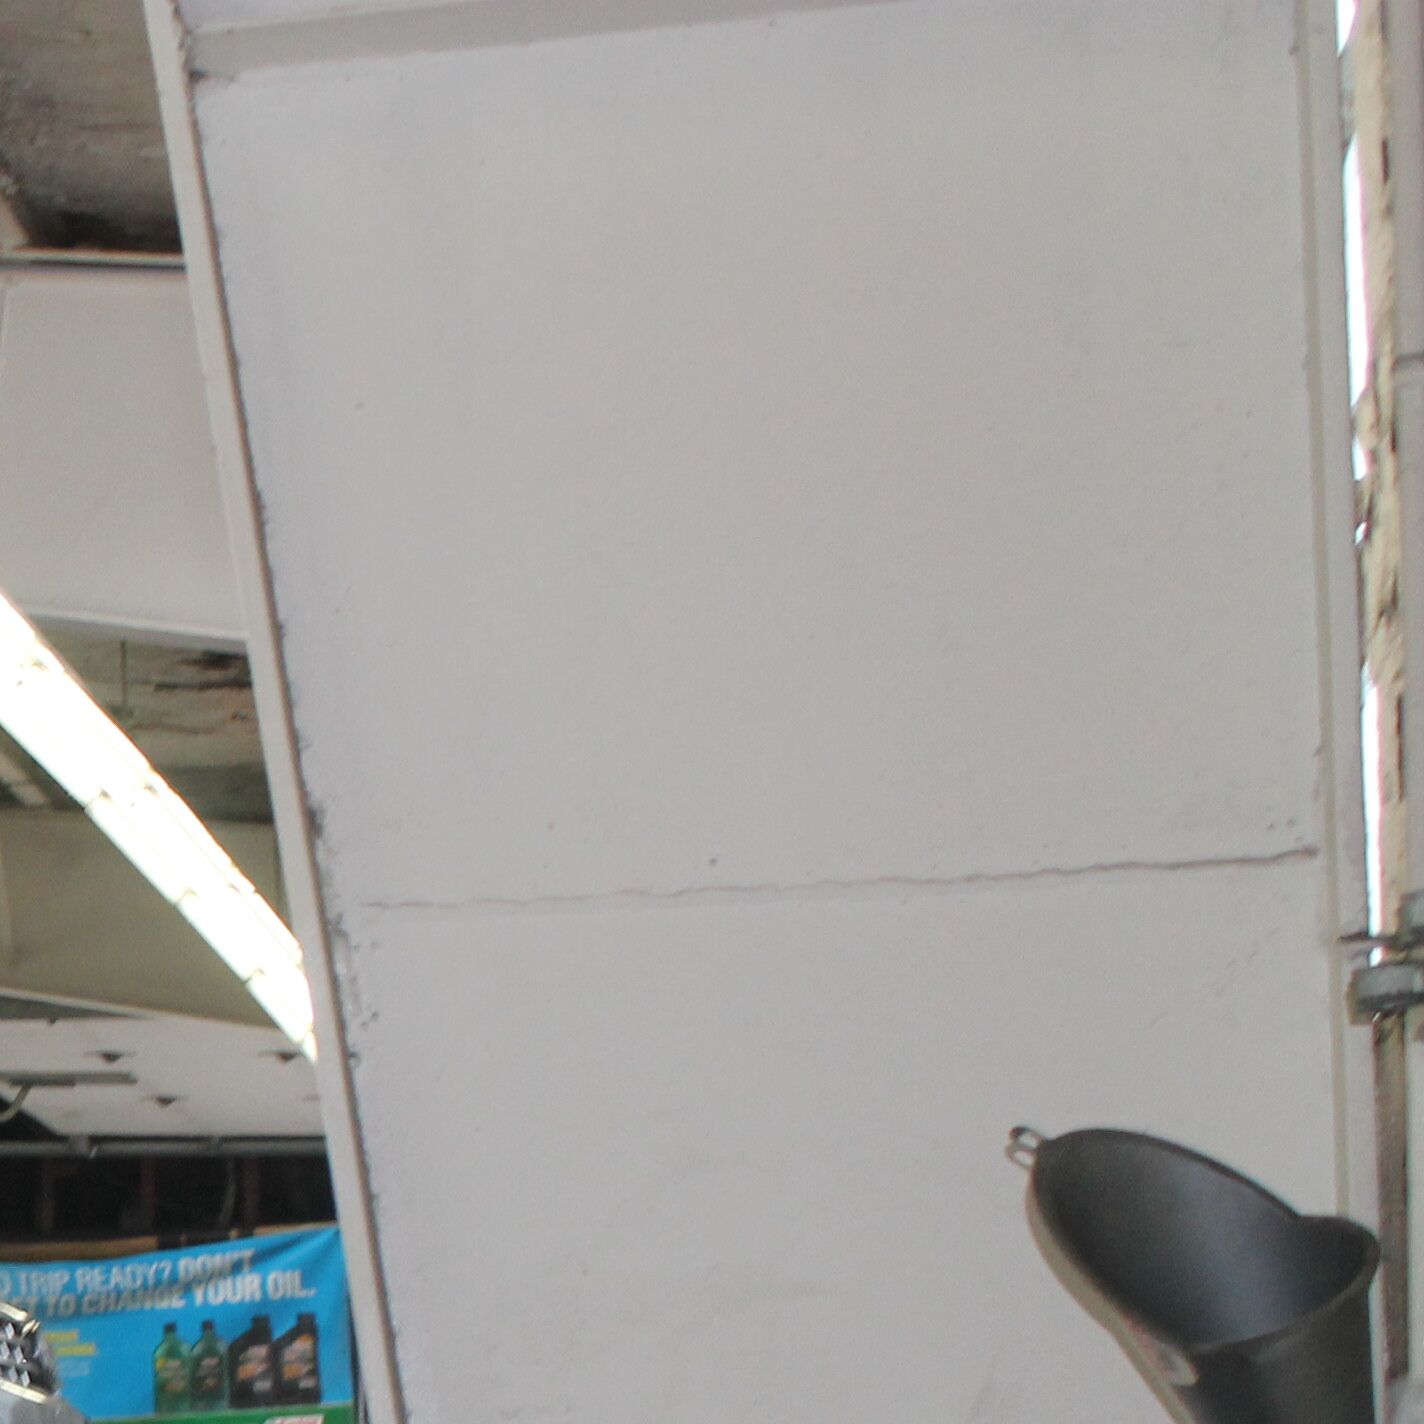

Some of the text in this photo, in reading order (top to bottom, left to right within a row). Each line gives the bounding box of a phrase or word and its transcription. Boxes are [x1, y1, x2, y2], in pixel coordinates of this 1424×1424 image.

[17, 1270, 70, 1298] TRIP
[74, 1260, 172, 1292] READY?
[45, 1294, 76, 1318] TO
[83, 1284, 186, 1314] CHANGE
[191, 1272, 261, 1306] YOUR
[267, 1270, 316, 1301] OIL.
